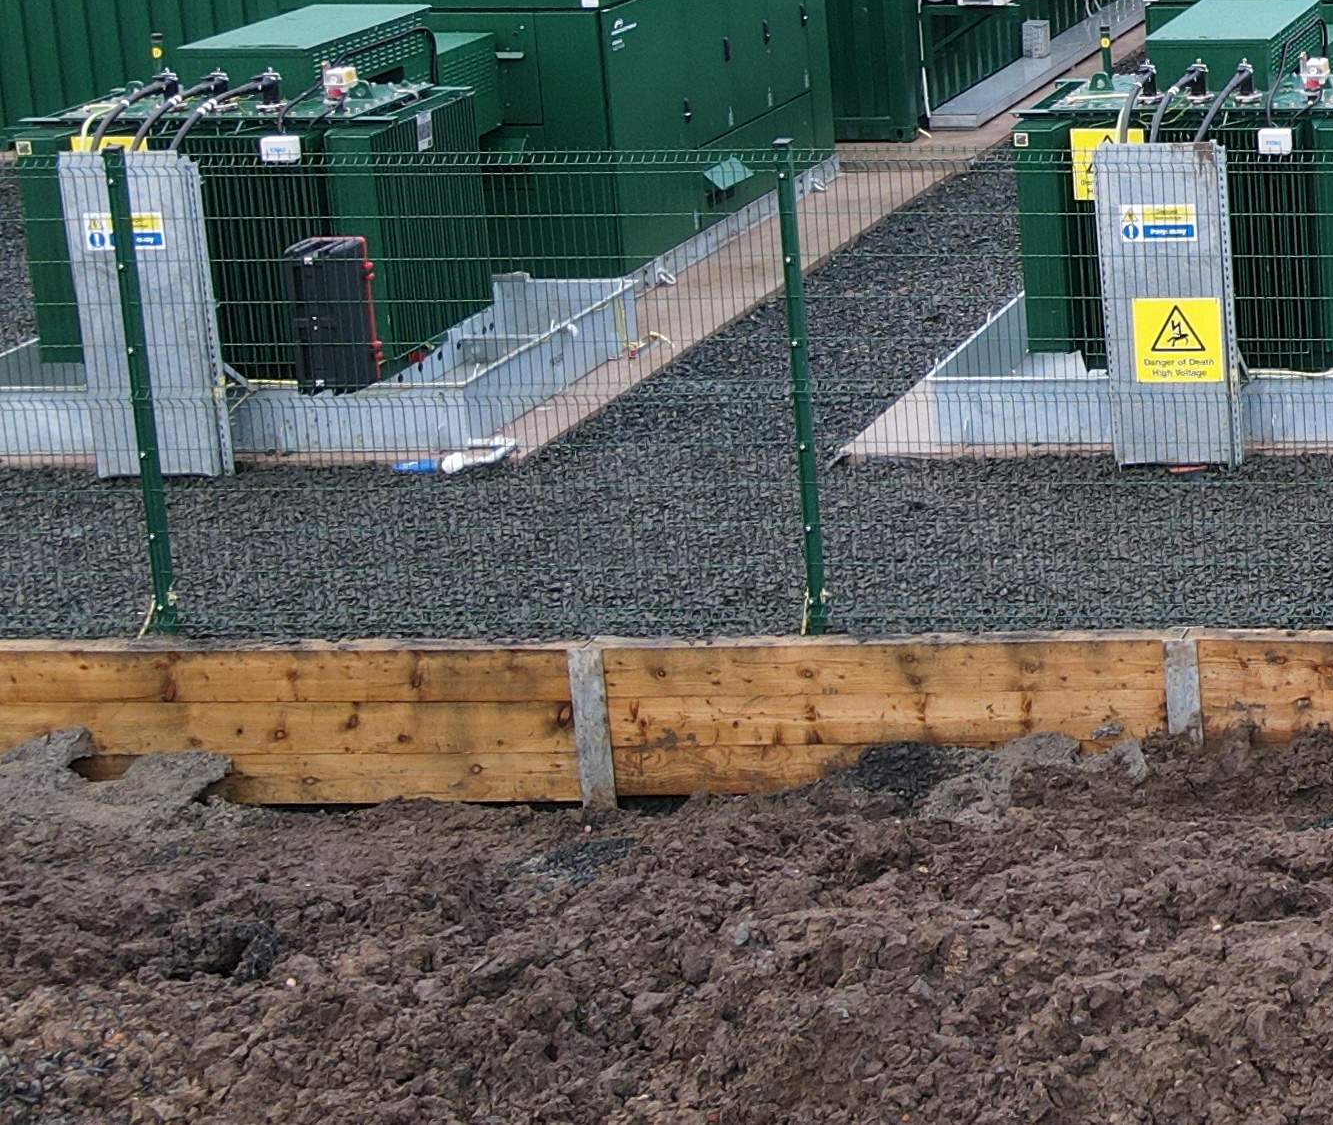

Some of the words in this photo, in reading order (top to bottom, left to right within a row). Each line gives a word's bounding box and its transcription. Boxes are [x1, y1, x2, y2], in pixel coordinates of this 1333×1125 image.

[1144, 358, 1174, 368] Danger
[1177, 358, 1186, 366] of
[1188, 358, 1215, 366] Death
[1152, 368, 1173, 378] High
[1175, 368, 1207, 379] Voltage
